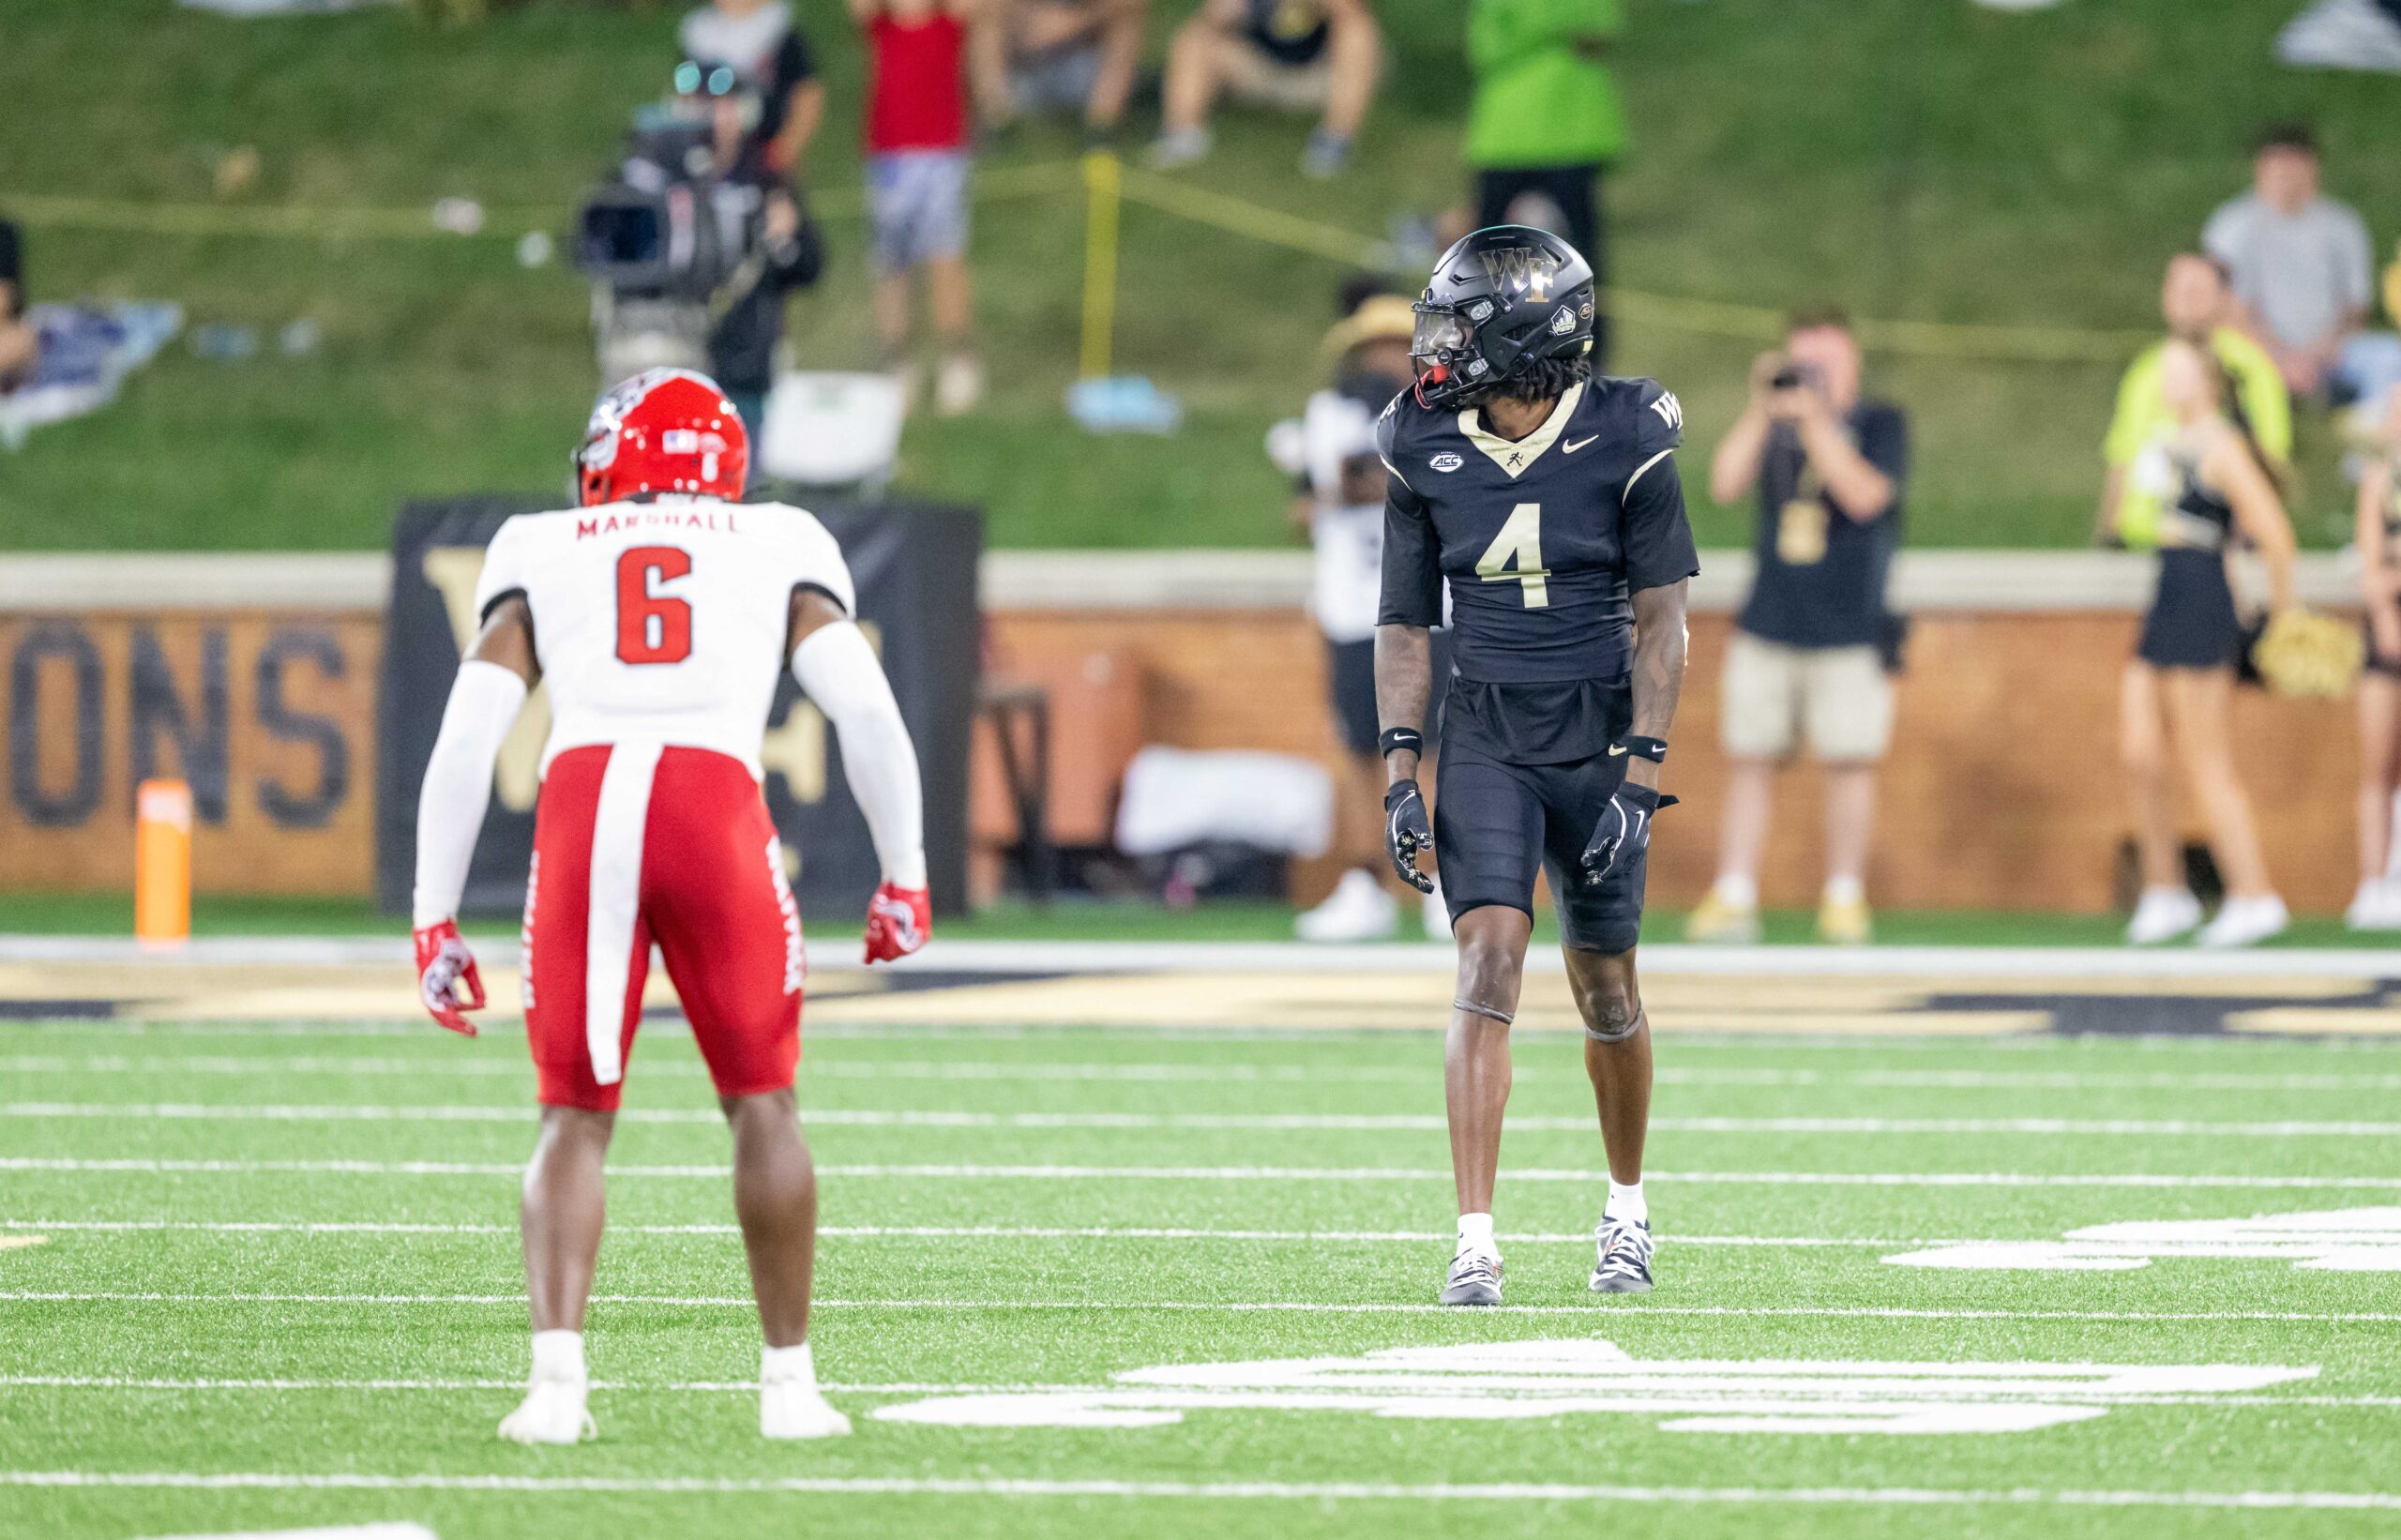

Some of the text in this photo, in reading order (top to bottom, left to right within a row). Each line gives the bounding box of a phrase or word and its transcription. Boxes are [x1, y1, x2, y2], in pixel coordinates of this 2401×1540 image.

[1478, 247, 1562, 303] WF
[1434, 456, 1459, 465] ACC
[615, 545, 692, 665] 6
[1474, 503, 1551, 609] 4
[9, 623, 351, 829] ONS
